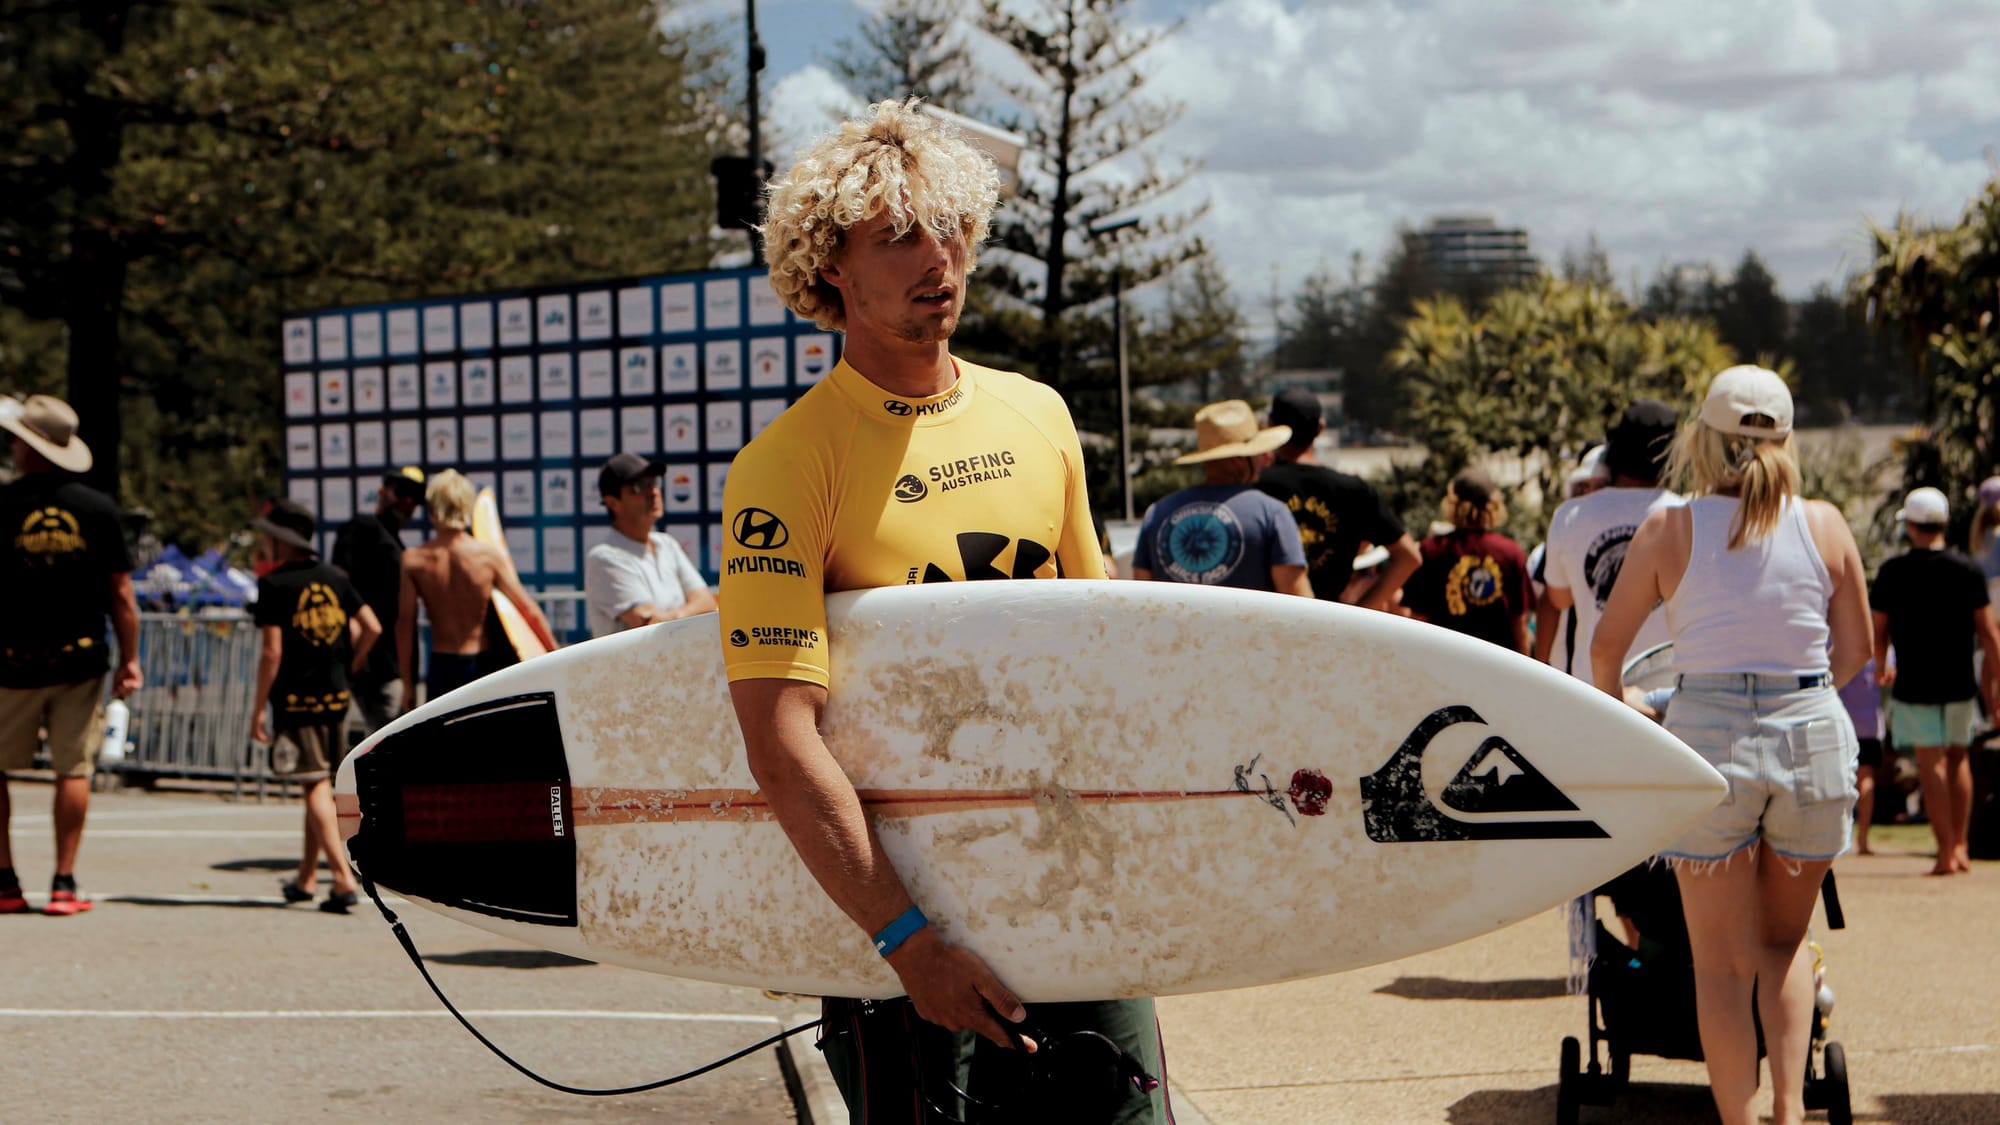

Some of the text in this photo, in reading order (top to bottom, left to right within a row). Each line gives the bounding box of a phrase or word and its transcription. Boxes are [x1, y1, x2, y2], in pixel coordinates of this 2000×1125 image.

[916, 389, 964, 416] HYUNDAI
[929, 450, 1015, 482] SURFING
[941, 467, 1012, 493] AUSTRALIA
[727, 555, 807, 579] HYUNDAI
[751, 627, 819, 642] SURFING
[758, 637, 815, 650] AUSTRALIA
[551, 787, 563, 835] BALLET
